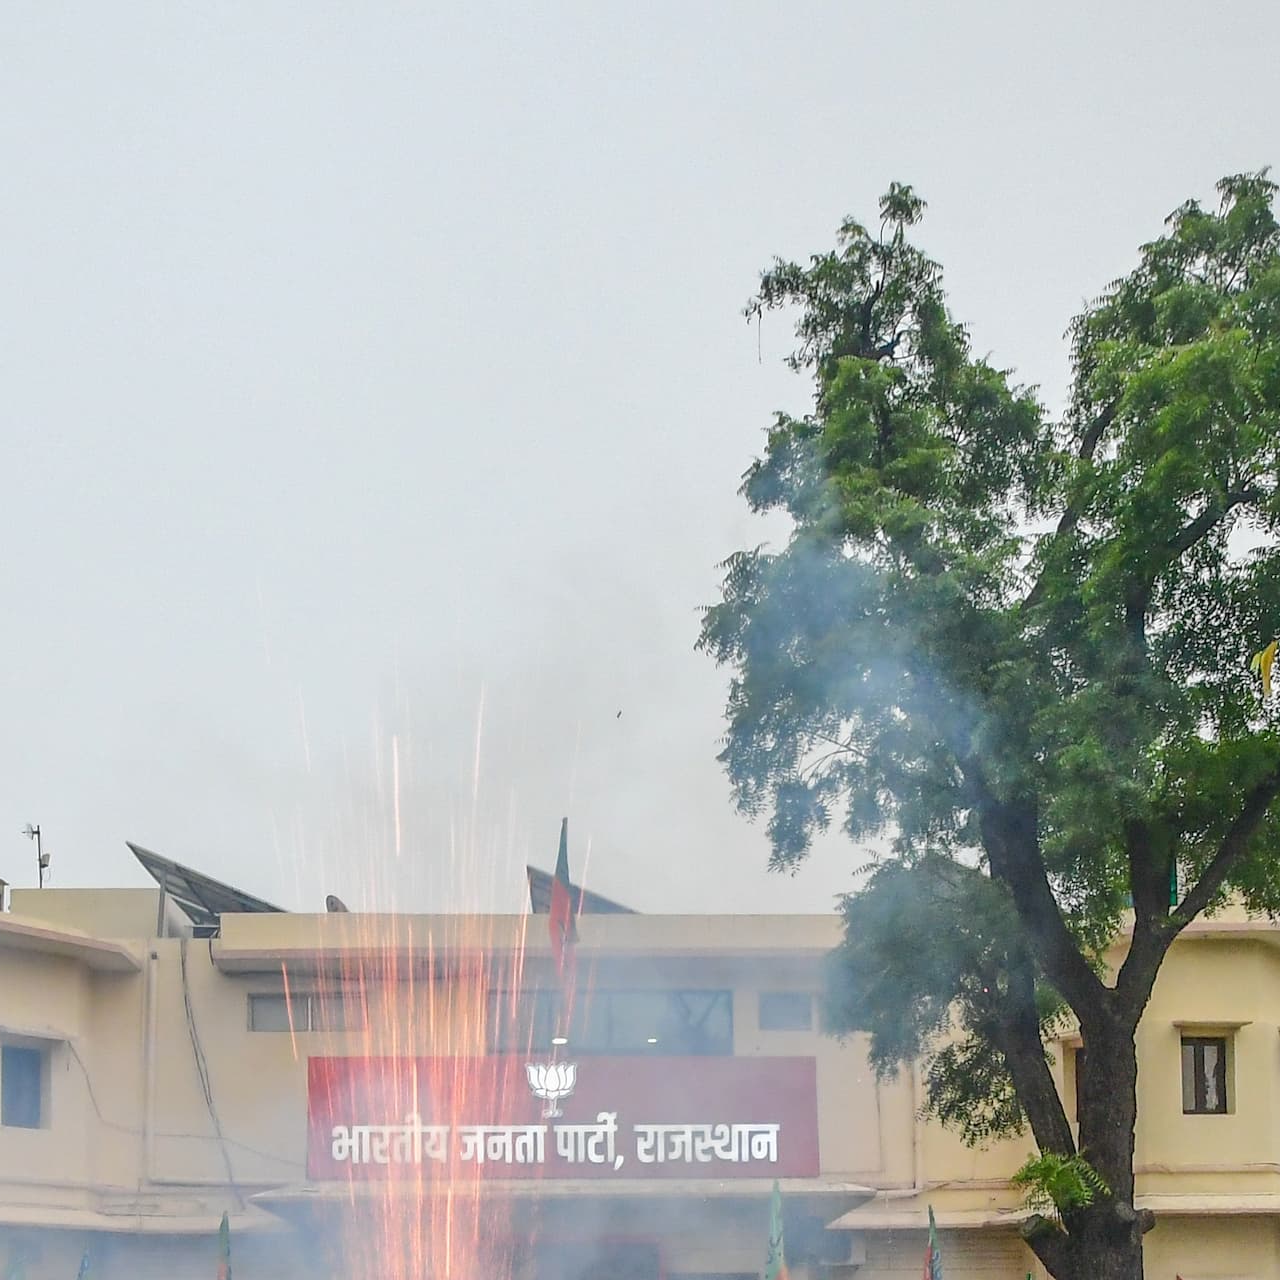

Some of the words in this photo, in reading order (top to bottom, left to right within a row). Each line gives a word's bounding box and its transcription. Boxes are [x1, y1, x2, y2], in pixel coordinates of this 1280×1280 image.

[331, 1114, 449, 1163] भारतीय
[459, 1124, 547, 1163] जनता
[553, 1112, 625, 1170] पार्टी,
[634, 1123, 780, 1163] राजस्थान
